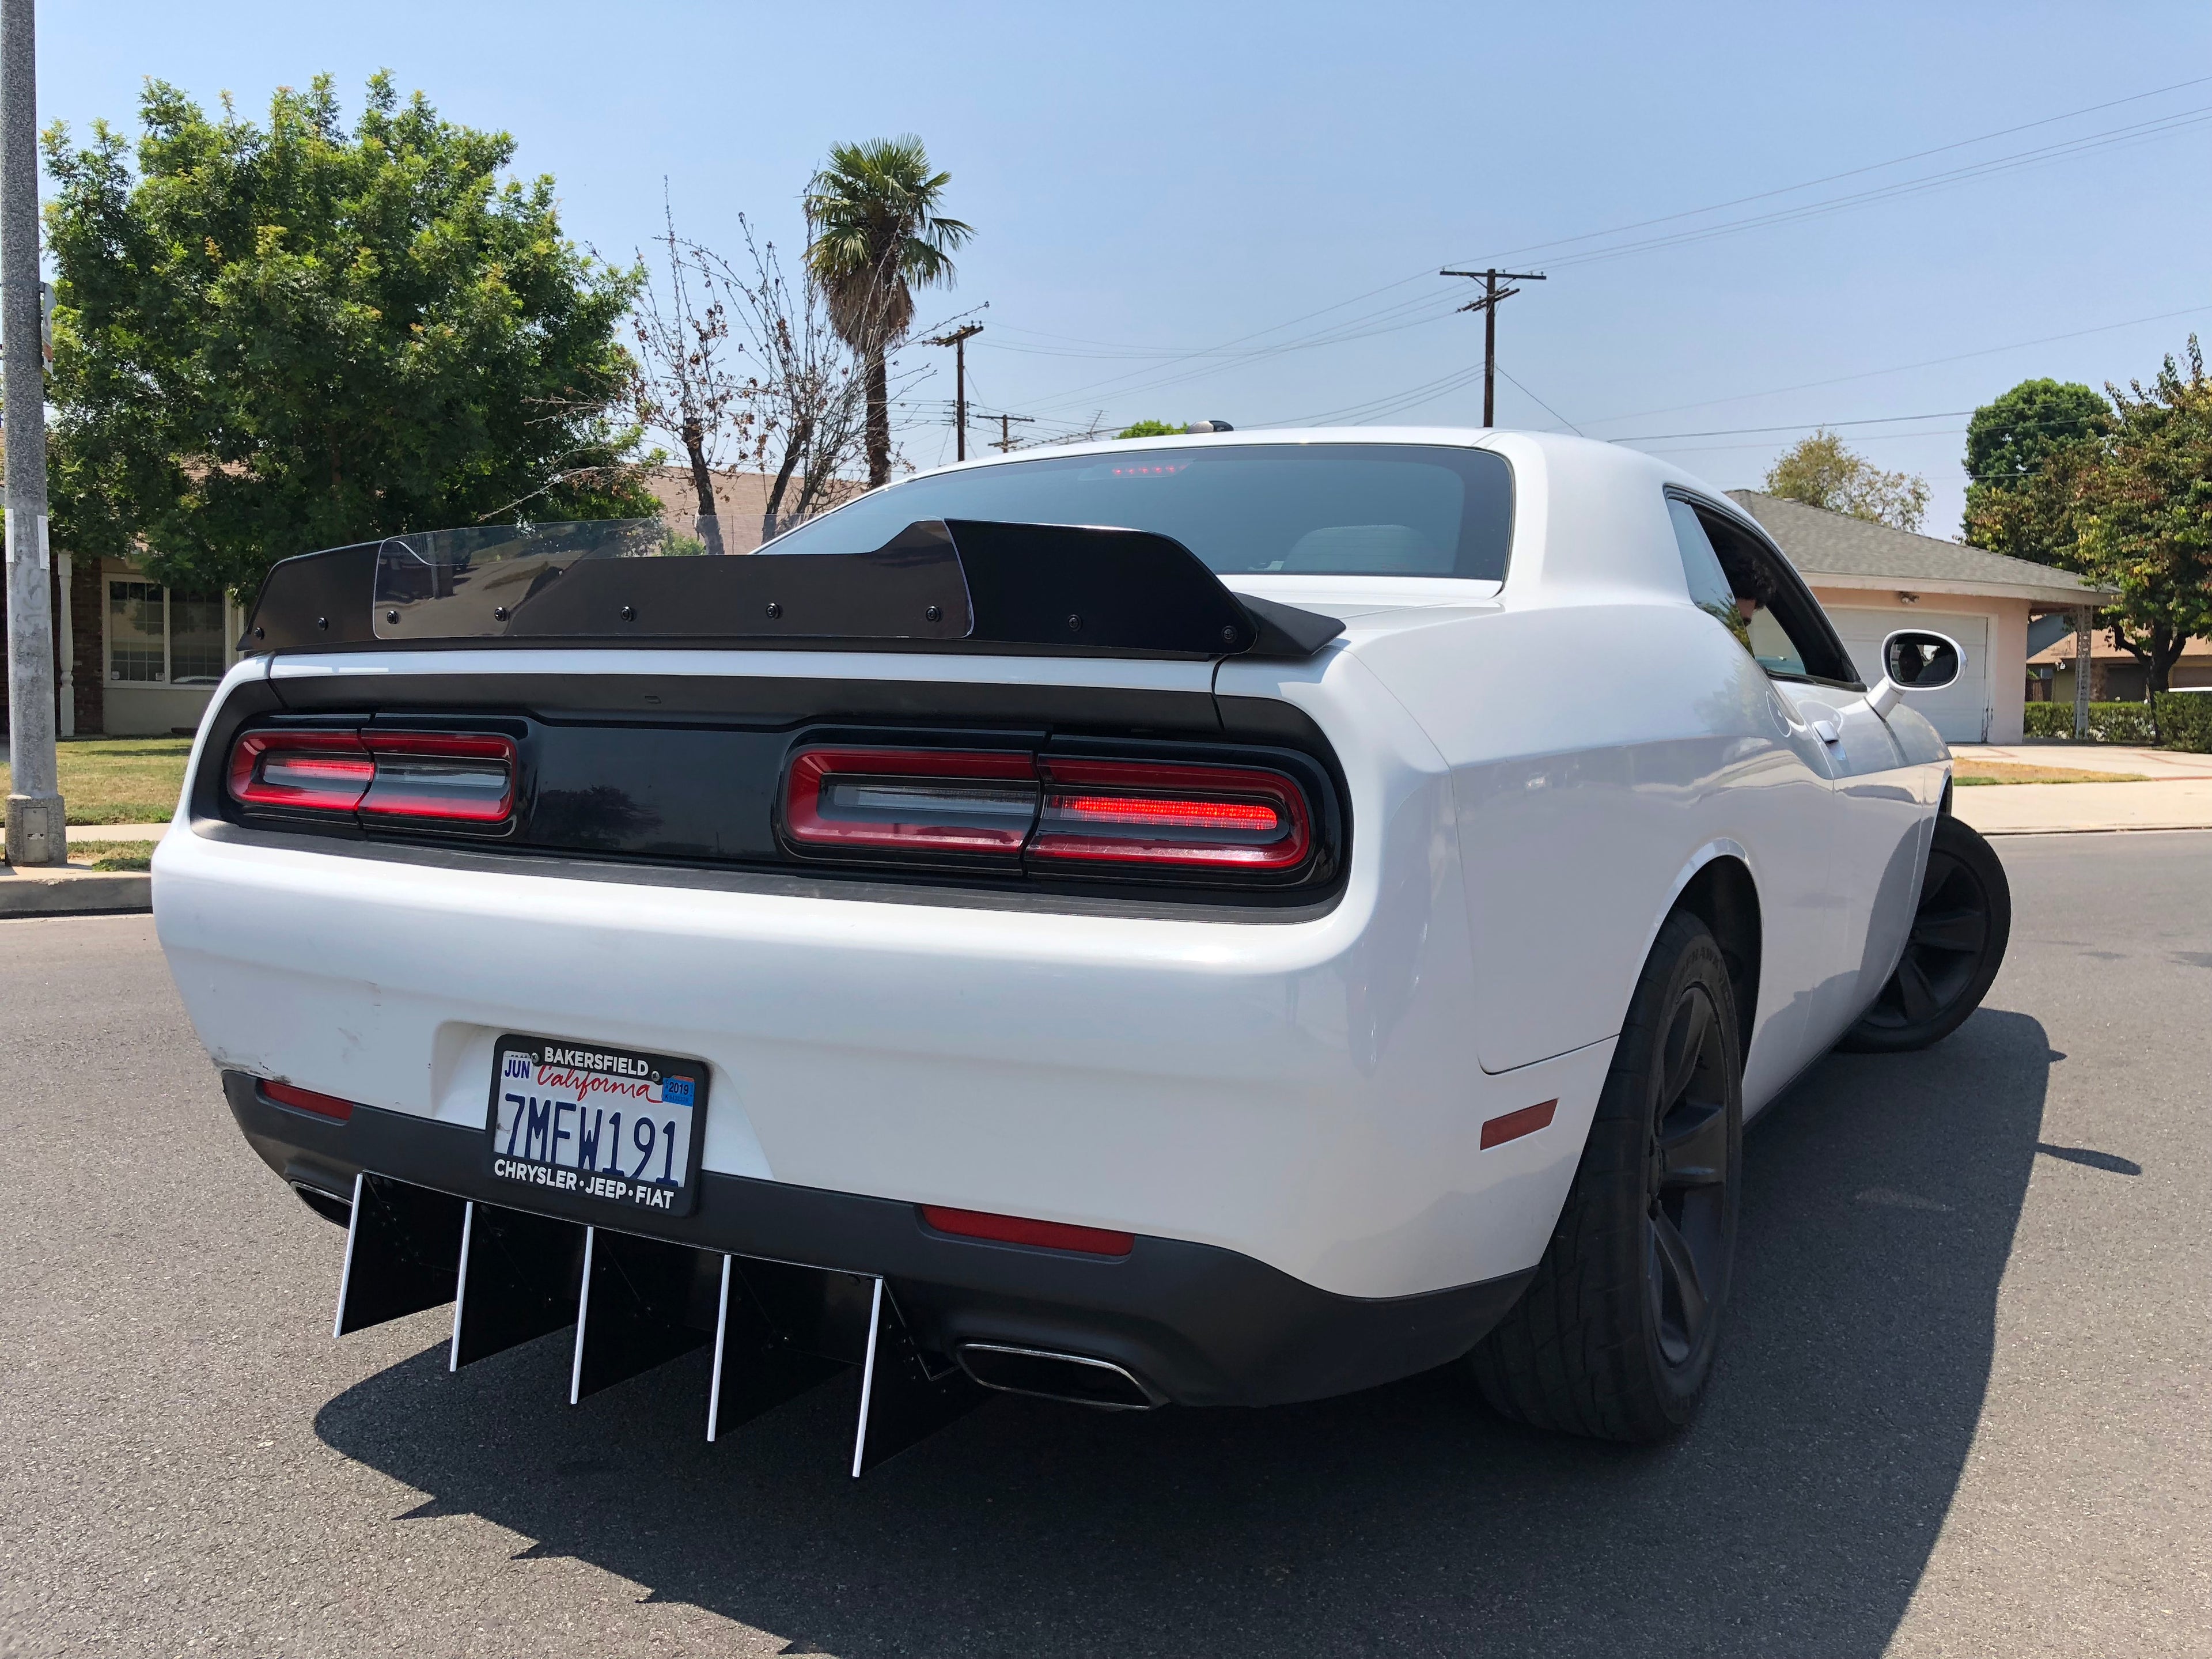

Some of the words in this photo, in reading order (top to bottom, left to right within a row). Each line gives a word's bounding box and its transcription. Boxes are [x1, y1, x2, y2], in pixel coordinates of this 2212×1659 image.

[505, 1059, 531, 1079] JUN
[544, 1047, 649, 1076] BAKERSFIELD
[537, 1065, 663, 1103] California
[668, 1081, 689, 1095] 2019
[505, 1093, 679, 1187] 7MFW191
[494, 1159, 577, 1191] CHRYSLER
[585, 1176, 627, 1200] JEEP
[635, 1185, 675, 1209] FIAT
